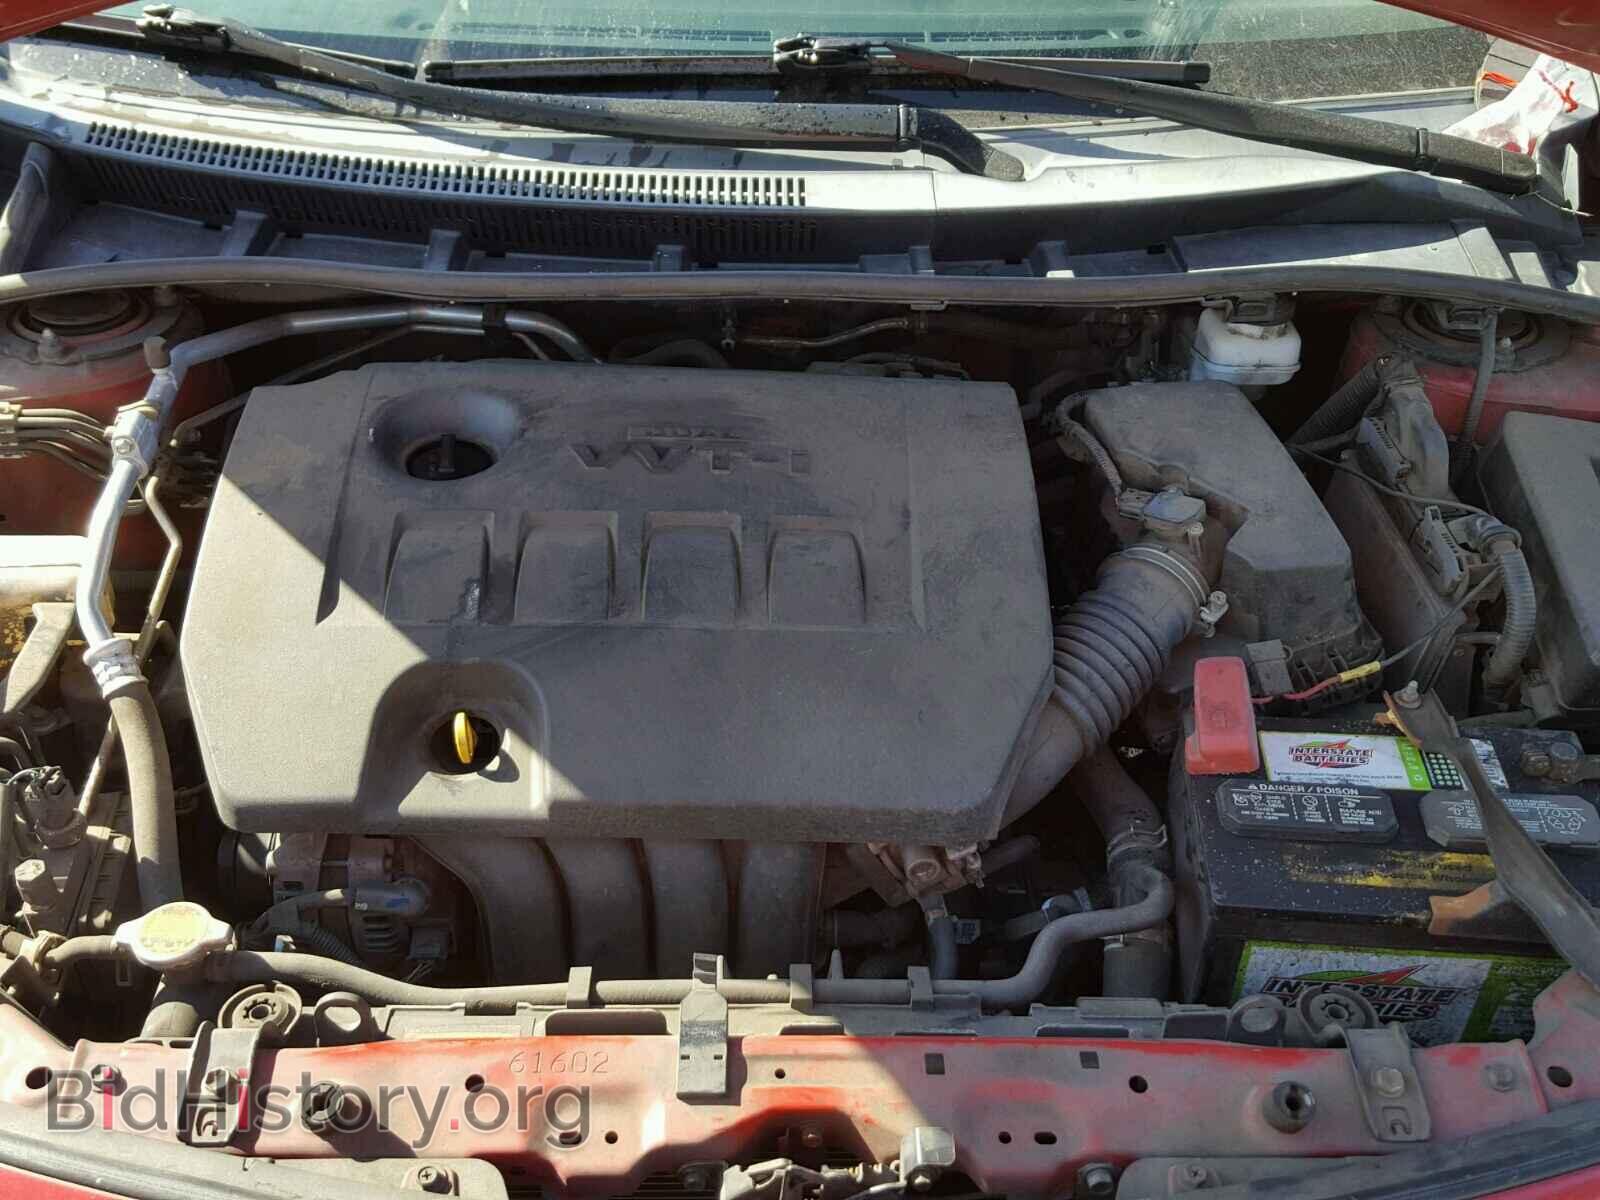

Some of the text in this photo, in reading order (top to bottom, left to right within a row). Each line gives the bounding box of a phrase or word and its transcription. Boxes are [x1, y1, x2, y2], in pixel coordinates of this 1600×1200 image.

[1290, 746, 1371, 758] INTERSTATE
[1294, 755, 1367, 765] BATTERIES
[1259, 783, 1305, 793] DANGER
[1316, 786, 1359, 796] POISON
[509, 1051, 609, 1074] 61602
